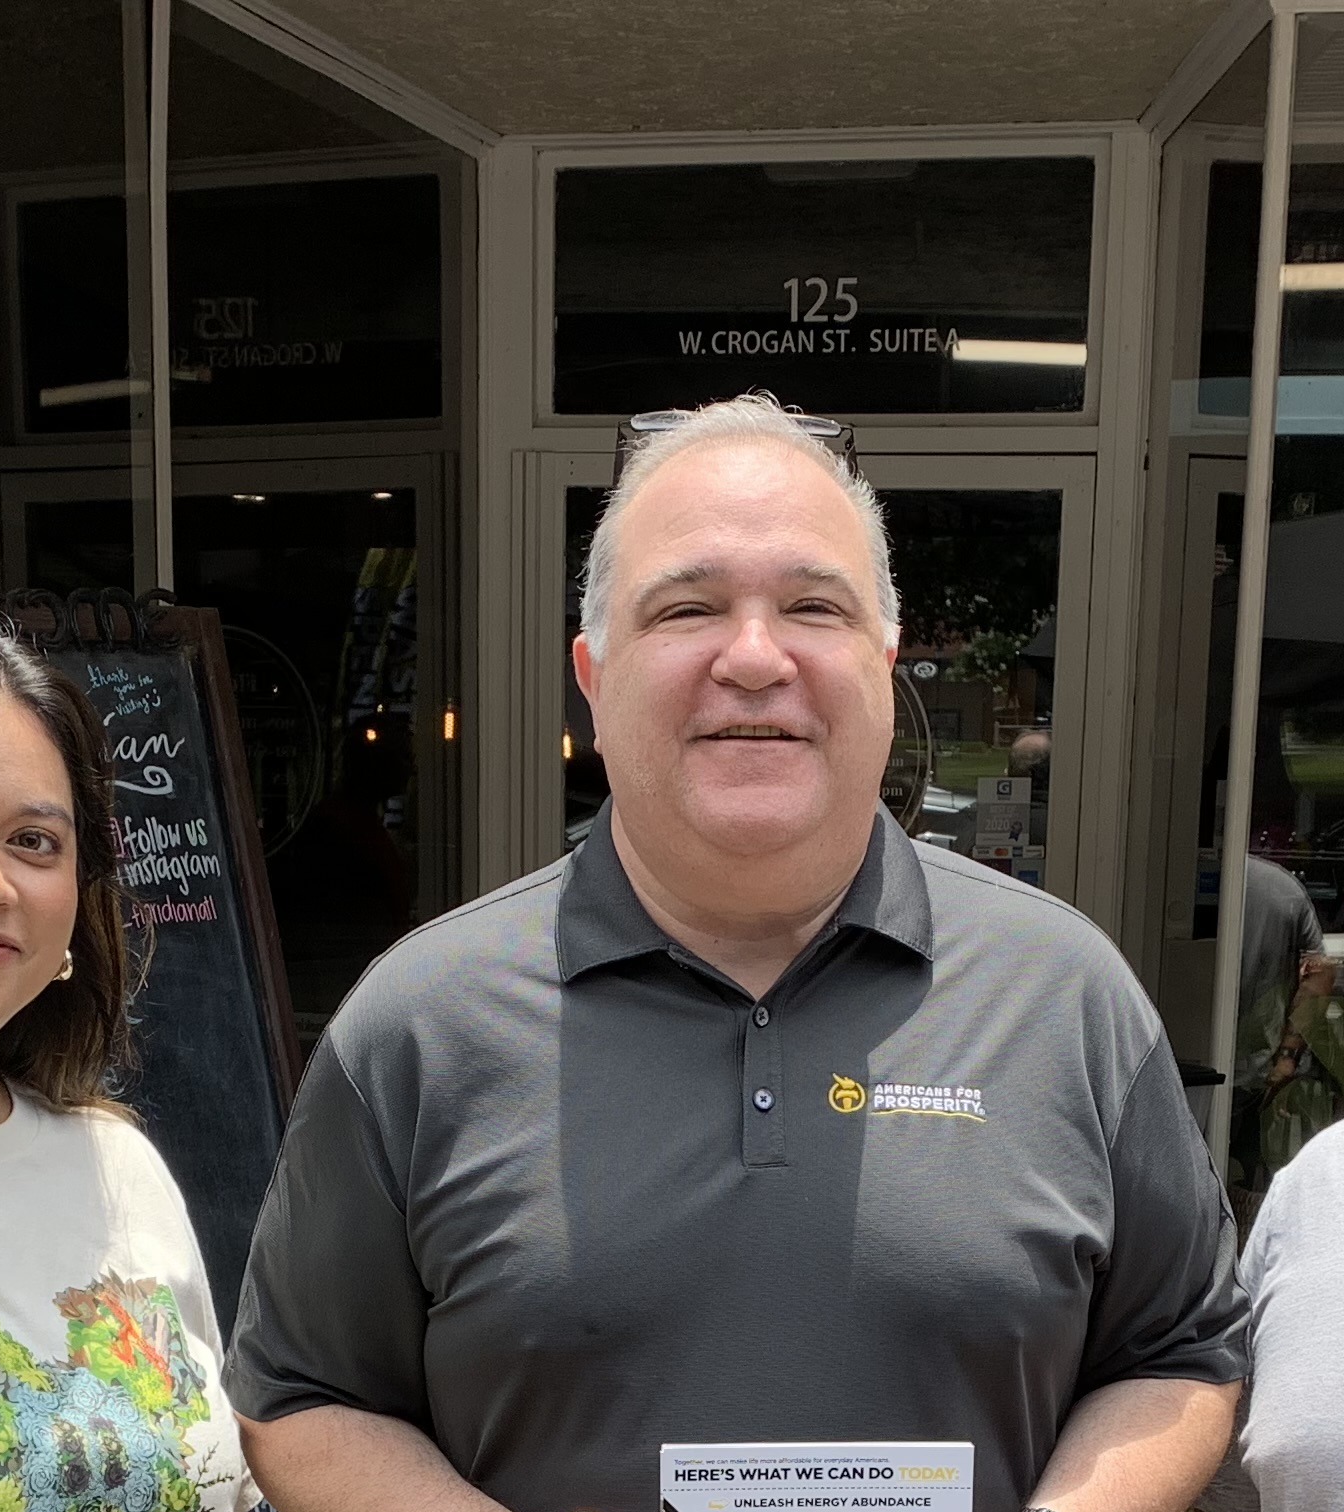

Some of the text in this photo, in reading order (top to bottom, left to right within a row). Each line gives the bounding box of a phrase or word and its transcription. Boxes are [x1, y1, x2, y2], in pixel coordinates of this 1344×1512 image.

[783, 277, 858, 323] 125
[678, 328, 960, 355] W. CROGAN ST. SUITE A
[123, 815, 209, 859] follow us
[874, 1084, 982, 1100] AMERICANS FOR
[873, 1095, 982, 1114] PROSPERITY
[674, 1466, 960, 1482] HERE'S WHAT WE CAN DO TODAY:
[734, 1497, 932, 1508] UNLEASH ENERGY ABUNDANCE
